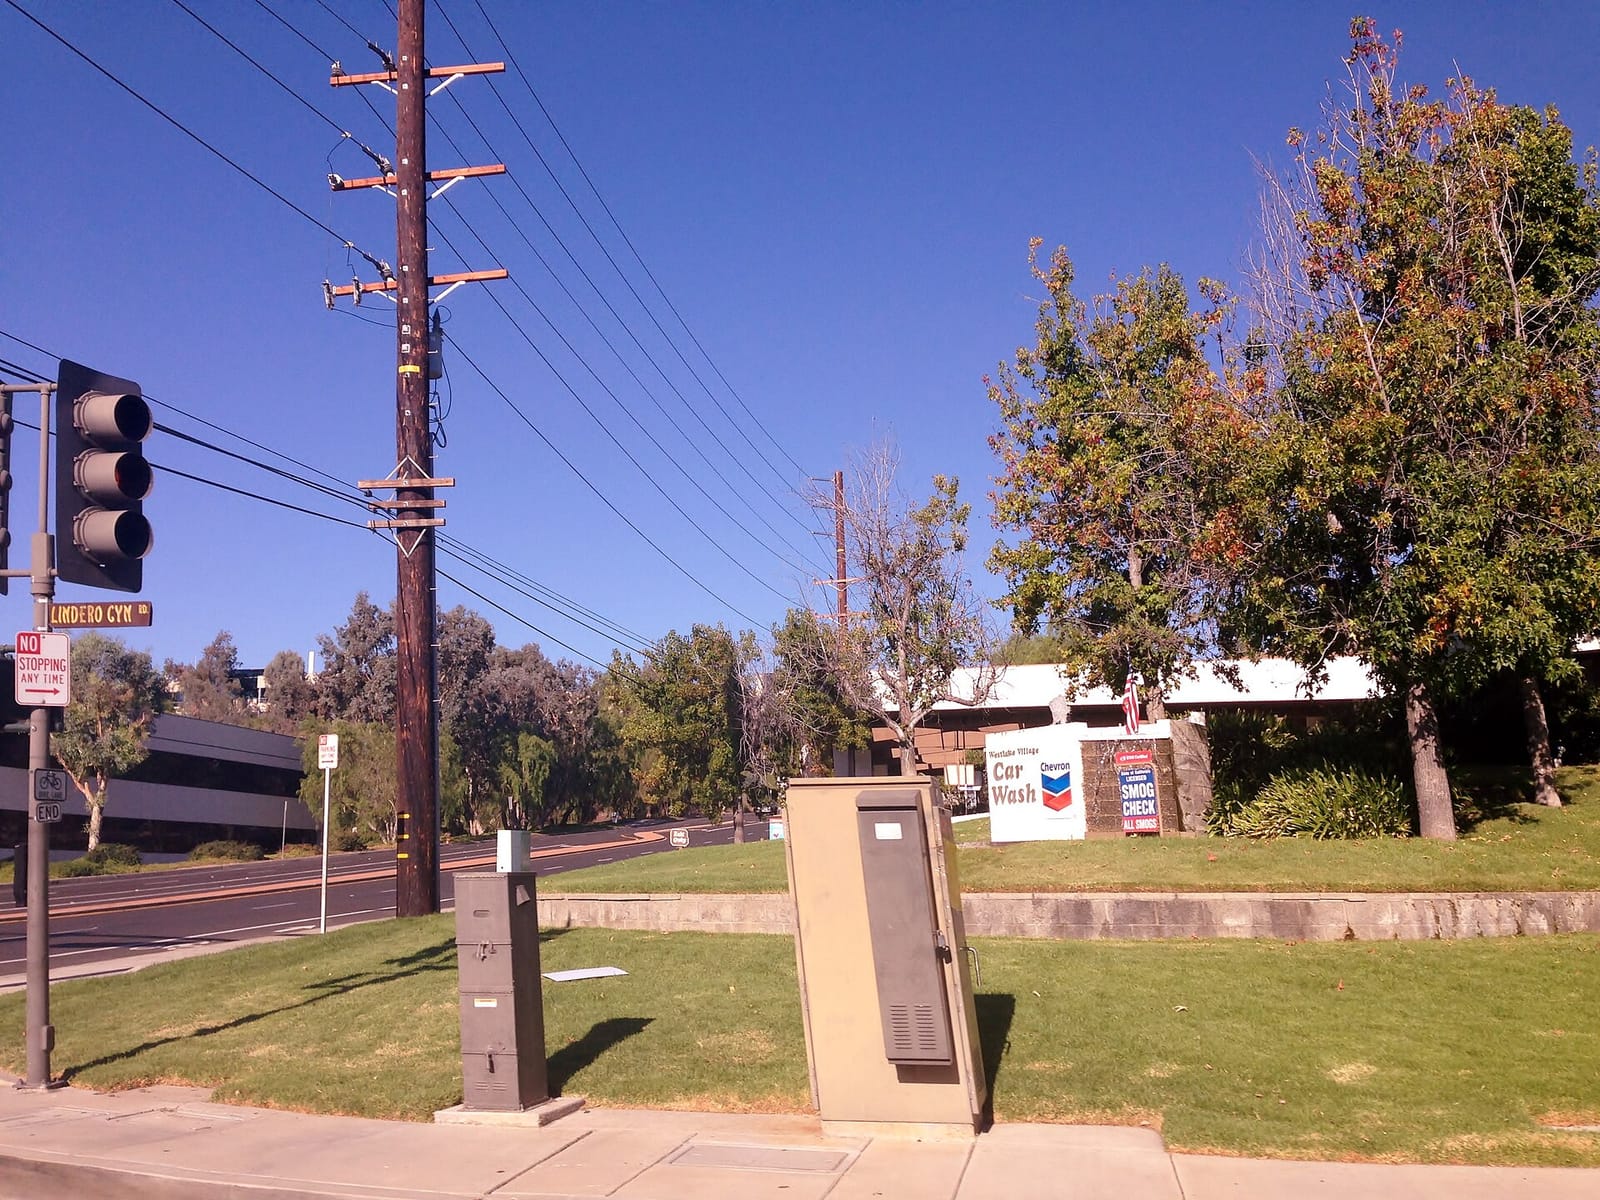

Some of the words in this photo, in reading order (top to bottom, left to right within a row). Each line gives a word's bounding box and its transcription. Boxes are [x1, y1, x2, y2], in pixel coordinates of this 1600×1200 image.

[51, 605, 103, 624] LINDERO
[20, 635, 38, 652] NO
[19, 656, 67, 672] STOPPING
[21, 673, 39, 683] ANY
[43, 674, 65, 685] TIME
[989, 749, 1015, 759] Westlake
[1017, 747, 1039, 756] Village
[993, 761, 1024, 782] Car
[1040, 762, 1071, 772] Chevron
[991, 783, 1037, 806] Wash
[1121, 782, 1155, 799] SMOG
[38, 804, 59, 820] END
[1122, 800, 1156, 816] CHECK
[1123, 819, 1135, 830] ALL
[1135, 818, 1158, 830] SMOGS
